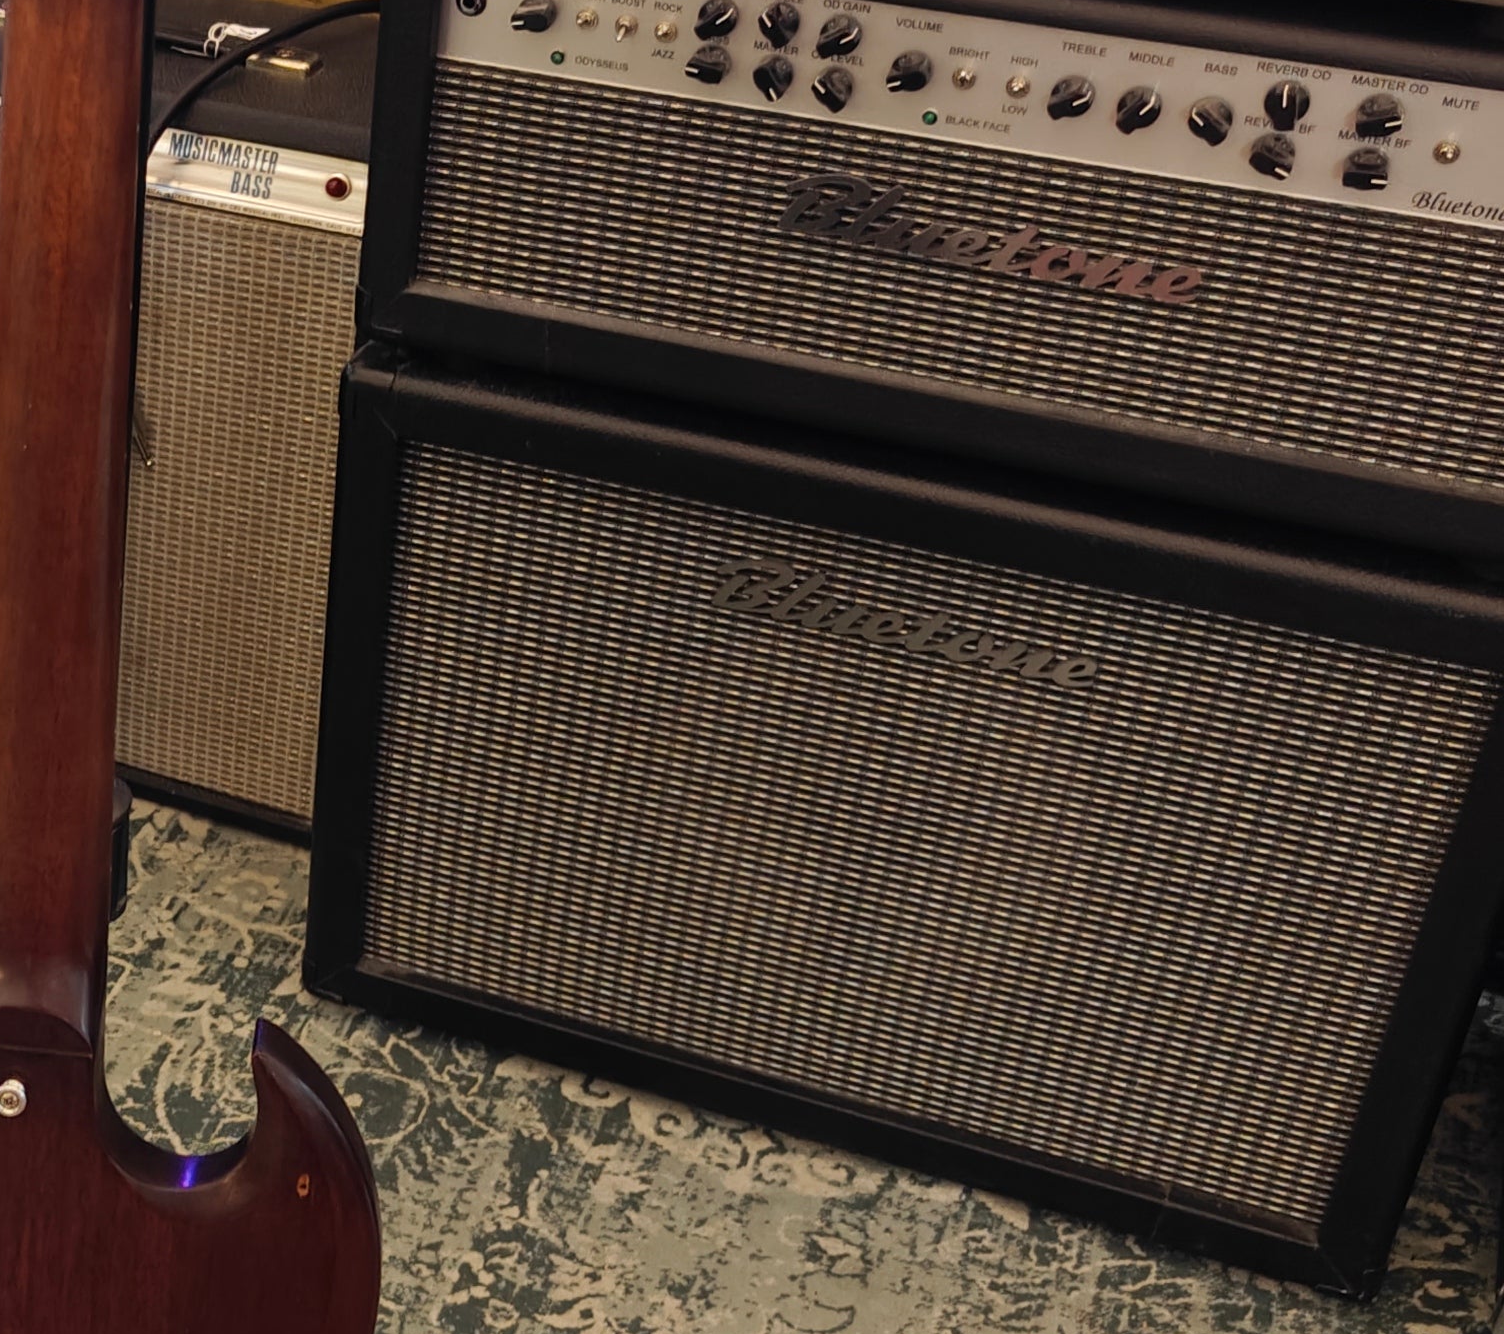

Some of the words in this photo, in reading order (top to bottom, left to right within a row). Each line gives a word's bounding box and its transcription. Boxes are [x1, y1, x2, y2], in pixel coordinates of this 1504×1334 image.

[654, 0, 684, 13] ROCK
[843, 0, 871, 14] GAIN
[896, 18, 943, 33] VOLUME
[651, 49, 675, 60] JAZZ
[948, 46, 989, 60] BRIGHT
[1062, 41, 1107, 58] TREBLE
[574, 56, 629, 72] ODYSSEUS
[1011, 55, 1039, 68] HIGH
[1129, 51, 1175, 67] MIDDLE
[1204, 62, 1238, 76] BASS
[1257, 61, 1308, 78] REVERB
[1312, 69, 1332, 81] OD
[1351, 75, 1405, 92] MASTER
[1409, 83, 1429, 95] OD
[1002, 103, 1028, 116] LOW
[1442, 96, 1480, 111] MUTE
[945, 115, 980, 129] BLACK
[982, 120, 1011, 133] FACE
[1299, 123, 1316, 135] BF
[1395, 137, 1412, 149] BF
[168, 132, 280, 175] MUSICMASTER
[230, 171, 273, 199] BASS
[777, 172, 1202, 304] Bluetone
[711, 556, 1098, 688] Bluetone
